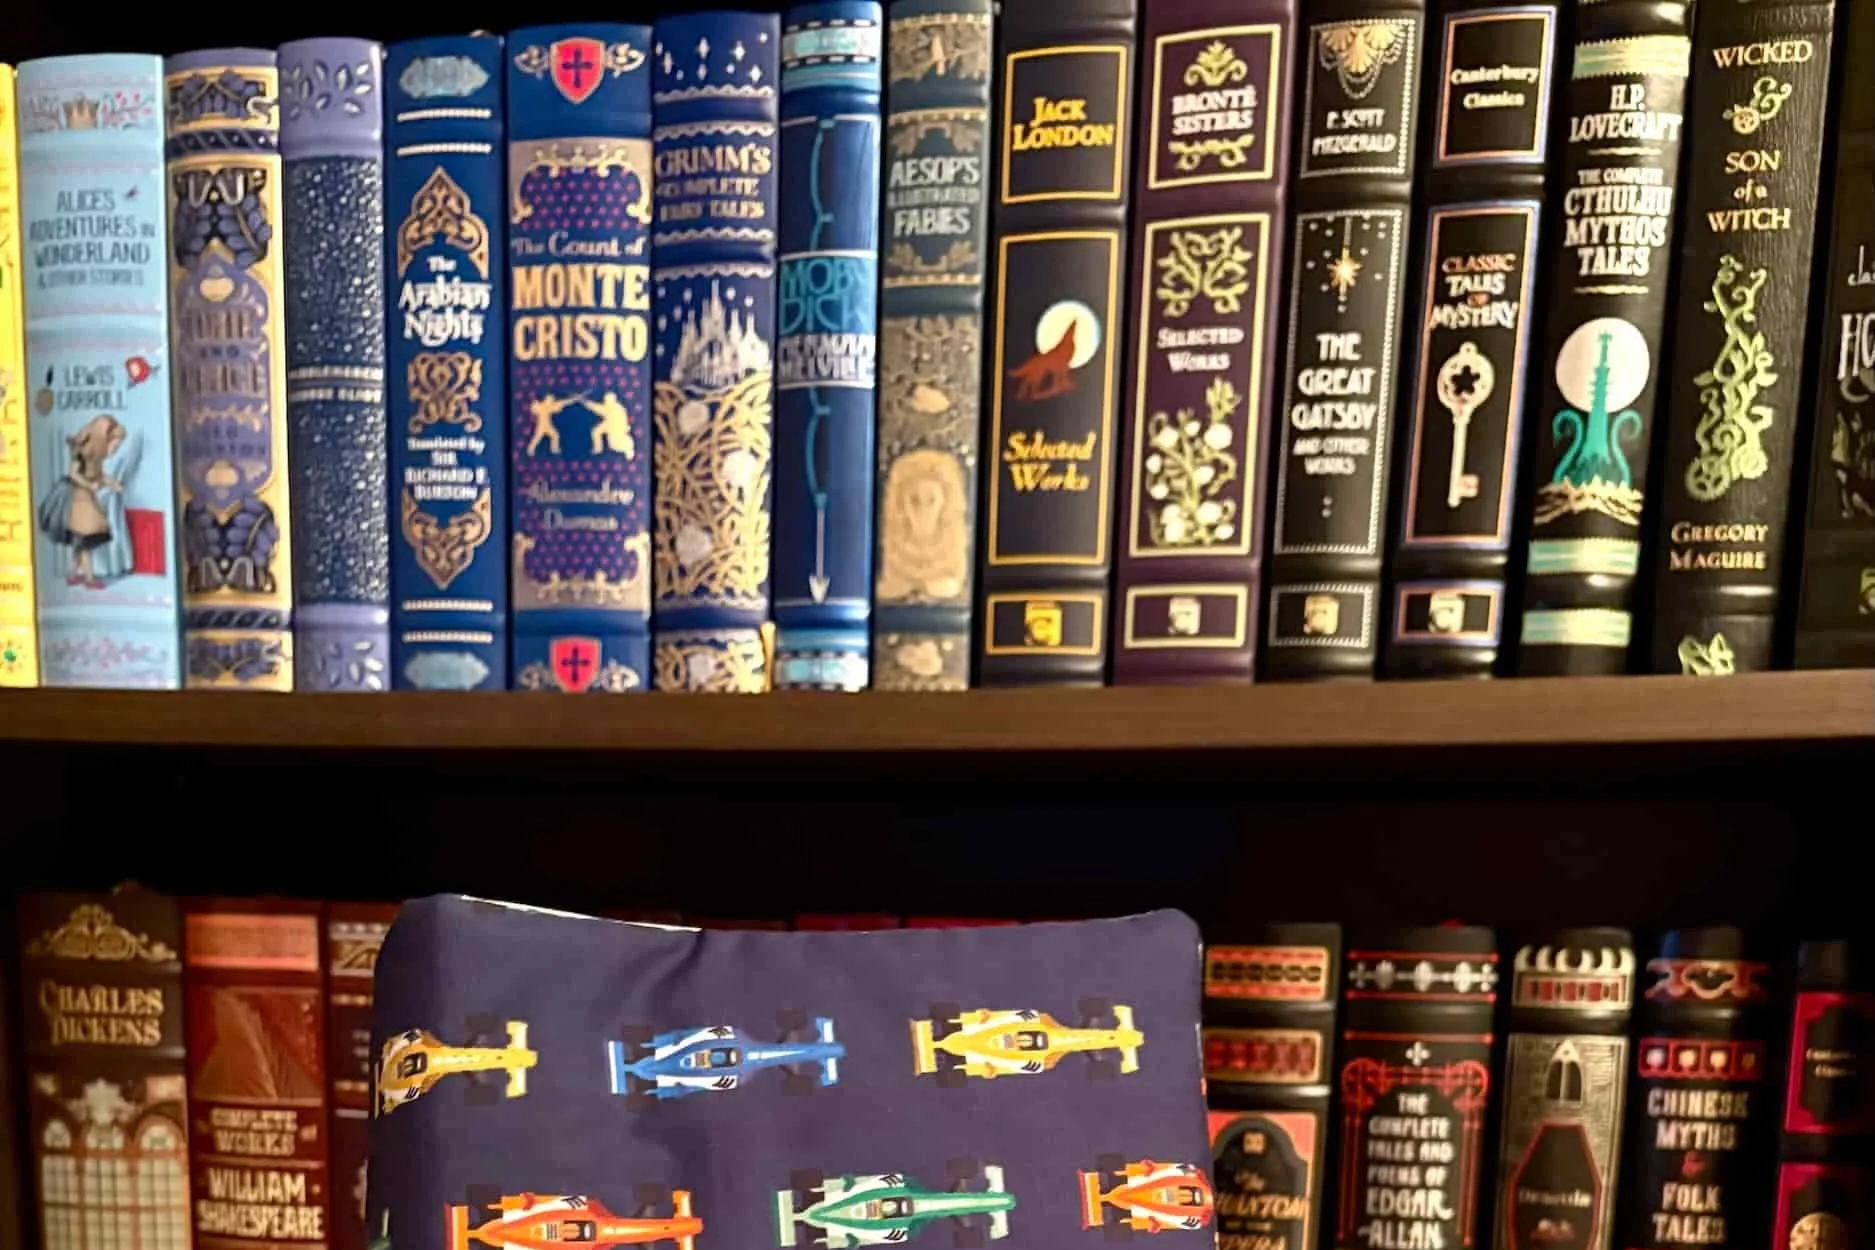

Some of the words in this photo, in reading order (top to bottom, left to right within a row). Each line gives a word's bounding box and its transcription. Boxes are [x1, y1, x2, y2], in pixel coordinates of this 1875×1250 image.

[1713, 40, 1813, 70] WICKED
[1451, 64, 1539, 85] Canterbury
[1463, 92, 1525, 110] Classics
[1610, 83, 1646, 112] H.P.
[1172, 110, 1253, 136] SISTERS
[1568, 111, 1683, 143] LOVECRAFT
[655, 142, 772, 176] GRIMM'S
[1311, 133, 1397, 156] FITZGERALD
[890, 156, 980, 188] AESOP'S
[1577, 168, 1602, 185] THE
[1603, 167, 1664, 185] COMPLETE
[1724, 150, 1780, 175] SON
[1563, 185, 1673, 217] CTHULHU
[1733, 178, 1754, 204] of
[1755, 186, 1768, 198] a
[30, 215, 137, 241] ADVENTURES
[893, 207, 972, 238] FABLES
[1563, 215, 1668, 247] MYTHOS
[1707, 207, 1791, 233] WITCH
[34, 241, 150, 267] WONDERLAND
[512, 238, 543, 256] The
[548, 231, 621, 257] Count
[624, 235, 646, 257] of
[426, 255, 457, 271] The
[1442, 253, 1517, 274] CLASSIC
[1577, 245, 1651, 277] TALES
[399, 276, 492, 311] Arabian
[512, 264, 650, 311] MONTE
[780, 258, 874, 299] MOBY
[1445, 272, 1507, 297] TALES
[404, 312, 485, 347] Nights
[779, 295, 874, 336] DICK
[1429, 300, 1519, 330] MYSTERY
[513, 314, 649, 362] CRISTO
[1316, 332, 1361, 361] THE
[64, 366, 114, 386] LEWIS
[1298, 367, 1376, 397] GREAT
[57, 389, 127, 410] CARROLL
[1291, 402, 1378, 431] GATSBY
[1003, 429, 1097, 462] Selected
[1007, 463, 1090, 492] Works
[40, 980, 164, 1018] CHARLES
[52, 1014, 162, 1047] DICKENS
[1398, 1092, 1428, 1115] THE
[1647, 1087, 1749, 1118] CHINESE
[1369, 1115, 1450, 1139] COMPLETE
[1656, 1118, 1736, 1150] MYTHS
[215, 1129, 295, 1156] WORKS
[1369, 1140, 1415, 1161] TALES
[1419, 1140, 1454, 1162] AND
[207, 1167, 306, 1205] WILLIAM
[1368, 1165, 1420, 1186] POEMS
[1425, 1165, 1448, 1187] OF
[1366, 1187, 1454, 1220] EDGAR
[1662, 1181, 1722, 1212] FOLK
[197, 1199, 325, 1240] SHAKESPEARE
[1358, 1219, 1444, 1250] ALLAN
[1652, 1213, 1728, 1244] TALES
